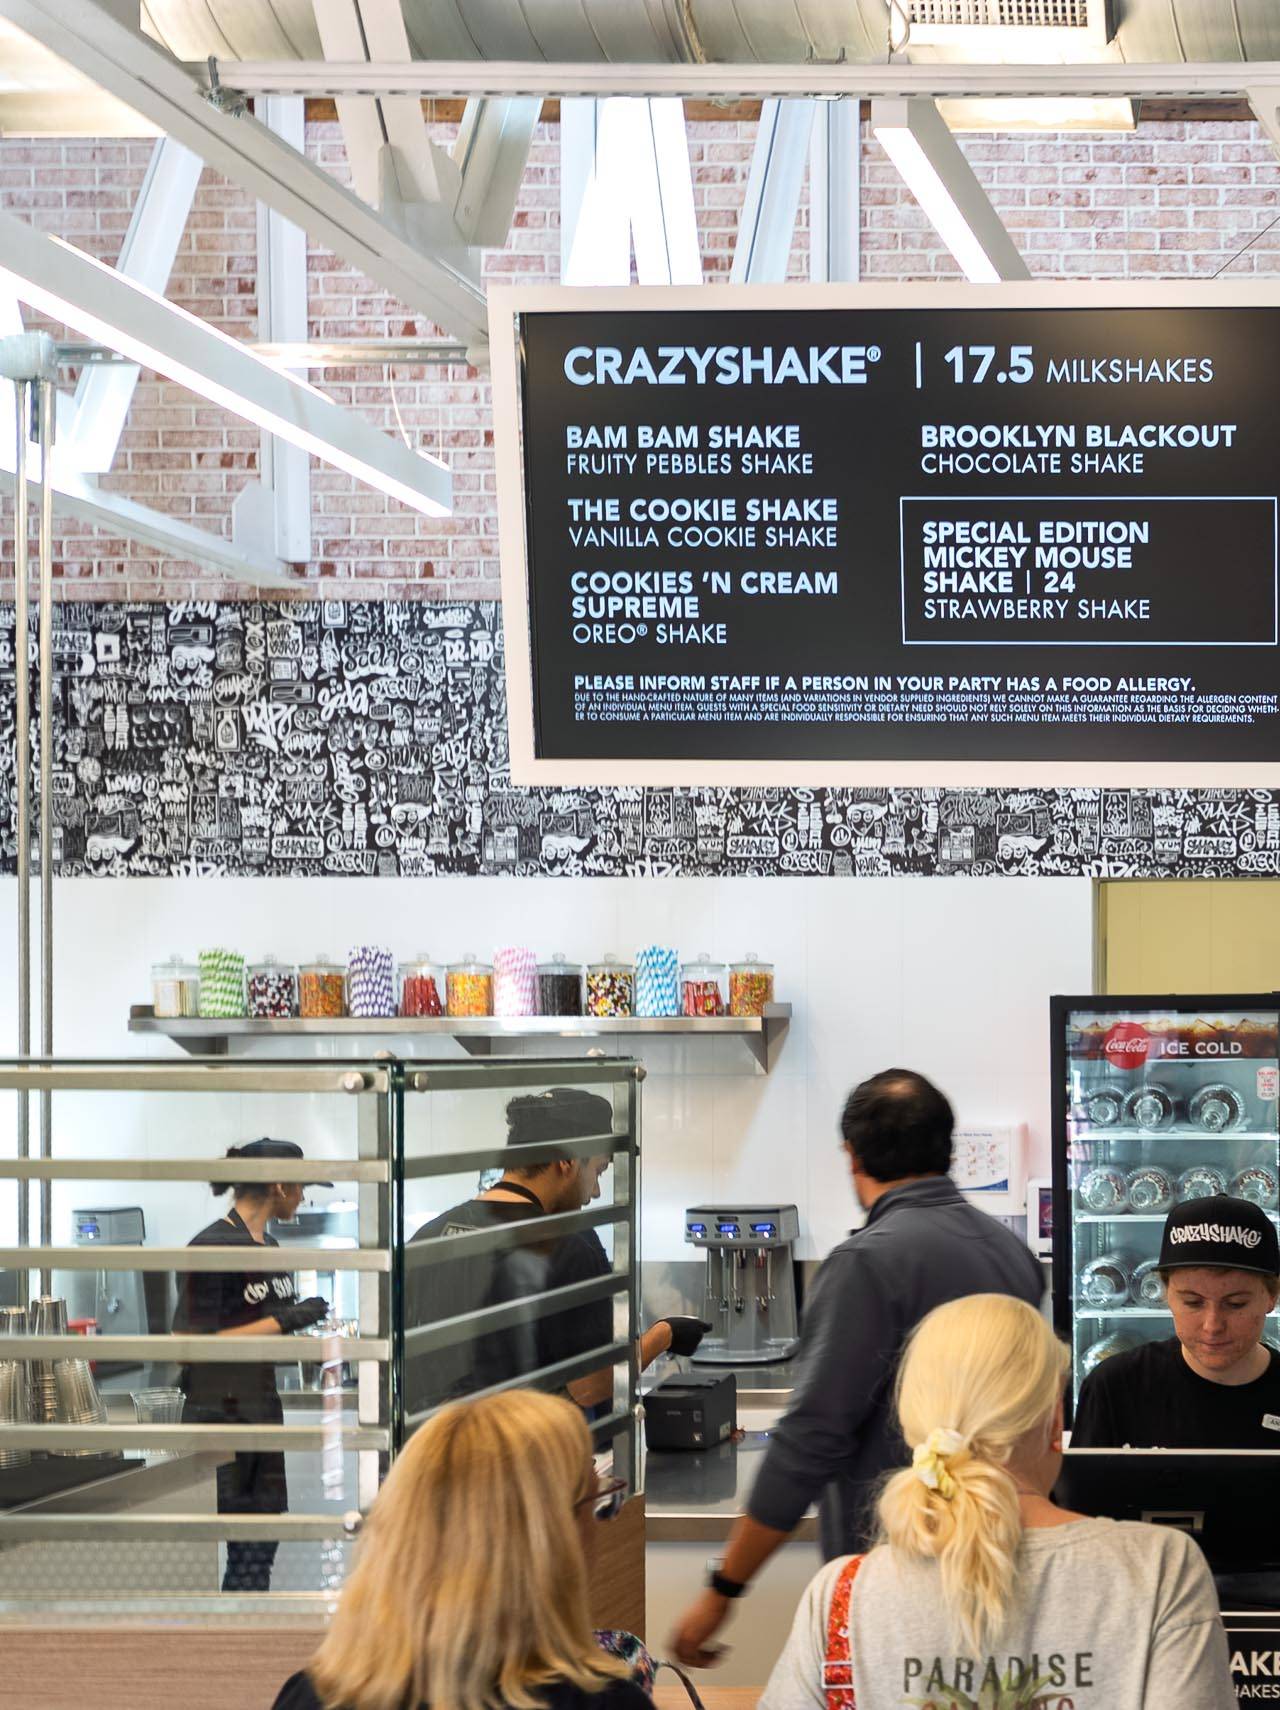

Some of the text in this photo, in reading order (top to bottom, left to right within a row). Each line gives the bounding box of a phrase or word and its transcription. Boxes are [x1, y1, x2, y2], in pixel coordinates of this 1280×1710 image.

[944, 346, 1033, 383] 17.5
[1046, 358, 1213, 382] MILKSHAKES
[566, 425, 800, 448] BAM BAM SHAKE
[921, 425, 1236, 448] BROOKLYN BLACKOUT
[567, 453, 812, 474] FRUITY PEBBLES SHAKE
[921, 453, 1143, 473] CHOCOLATE SHAKE
[567, 498, 838, 521] THE COOKIE SHAKE
[568, 526, 836, 547] VANILLA COOKIE SHAKE
[922, 521, 1148, 544] SPECIAL EDITION
[924, 546, 1132, 568] MICKEY MOUSE
[570, 571, 692, 594] COOKIES
[740, 571, 837, 594] CREAM
[923, 570, 1075, 593] SHAKE 24
[572, 596, 699, 618] SUPREME
[924, 598, 1149, 618] STRAWBERRY SHAKE
[656, 623, 726, 643] SHAKE
[574, 675, 1195, 691] PLEASE INFORM STAFF IF A PERSON IN YOUR PARTY HAS A FOOD ALLERGY.
[1160, 1042, 1242, 1055] ICE COLD
[904, 1652, 1094, 1693] PARADISE
